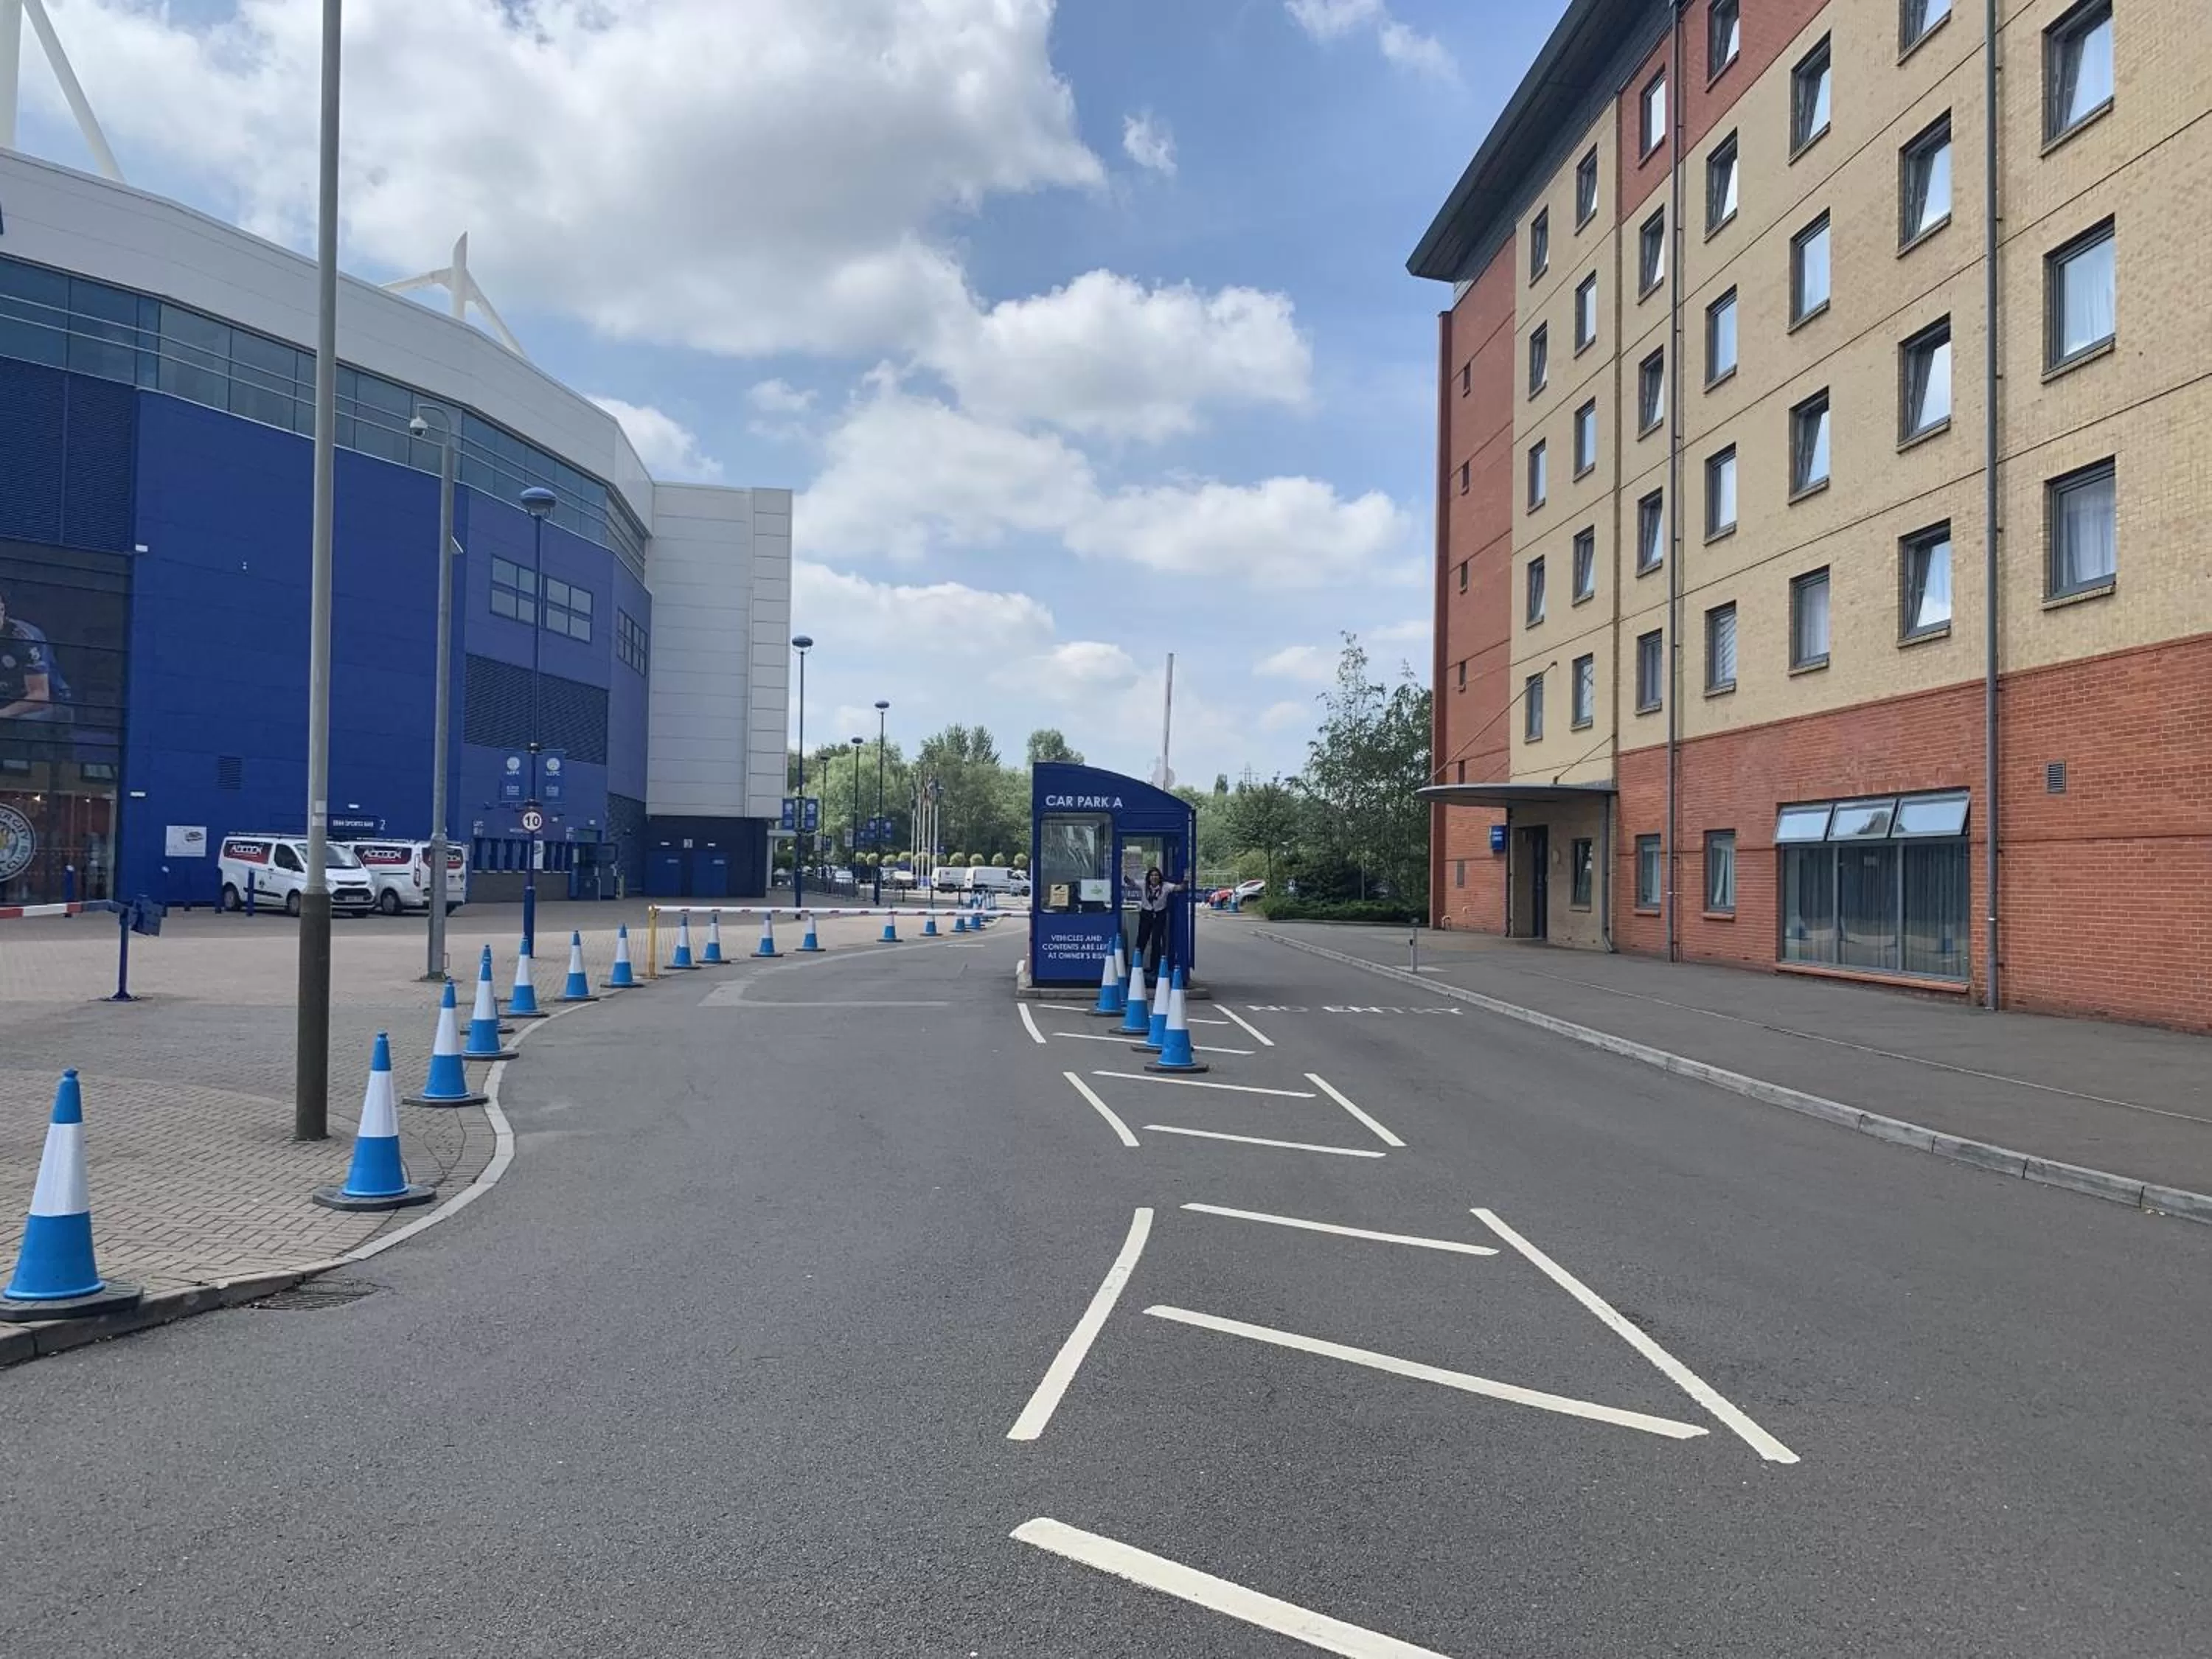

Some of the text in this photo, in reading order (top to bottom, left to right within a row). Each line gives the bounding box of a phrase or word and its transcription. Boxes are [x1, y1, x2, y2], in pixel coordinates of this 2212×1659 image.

[1045, 795, 1123, 808] CAR PARK A
[526, 815, 540, 827] 10
